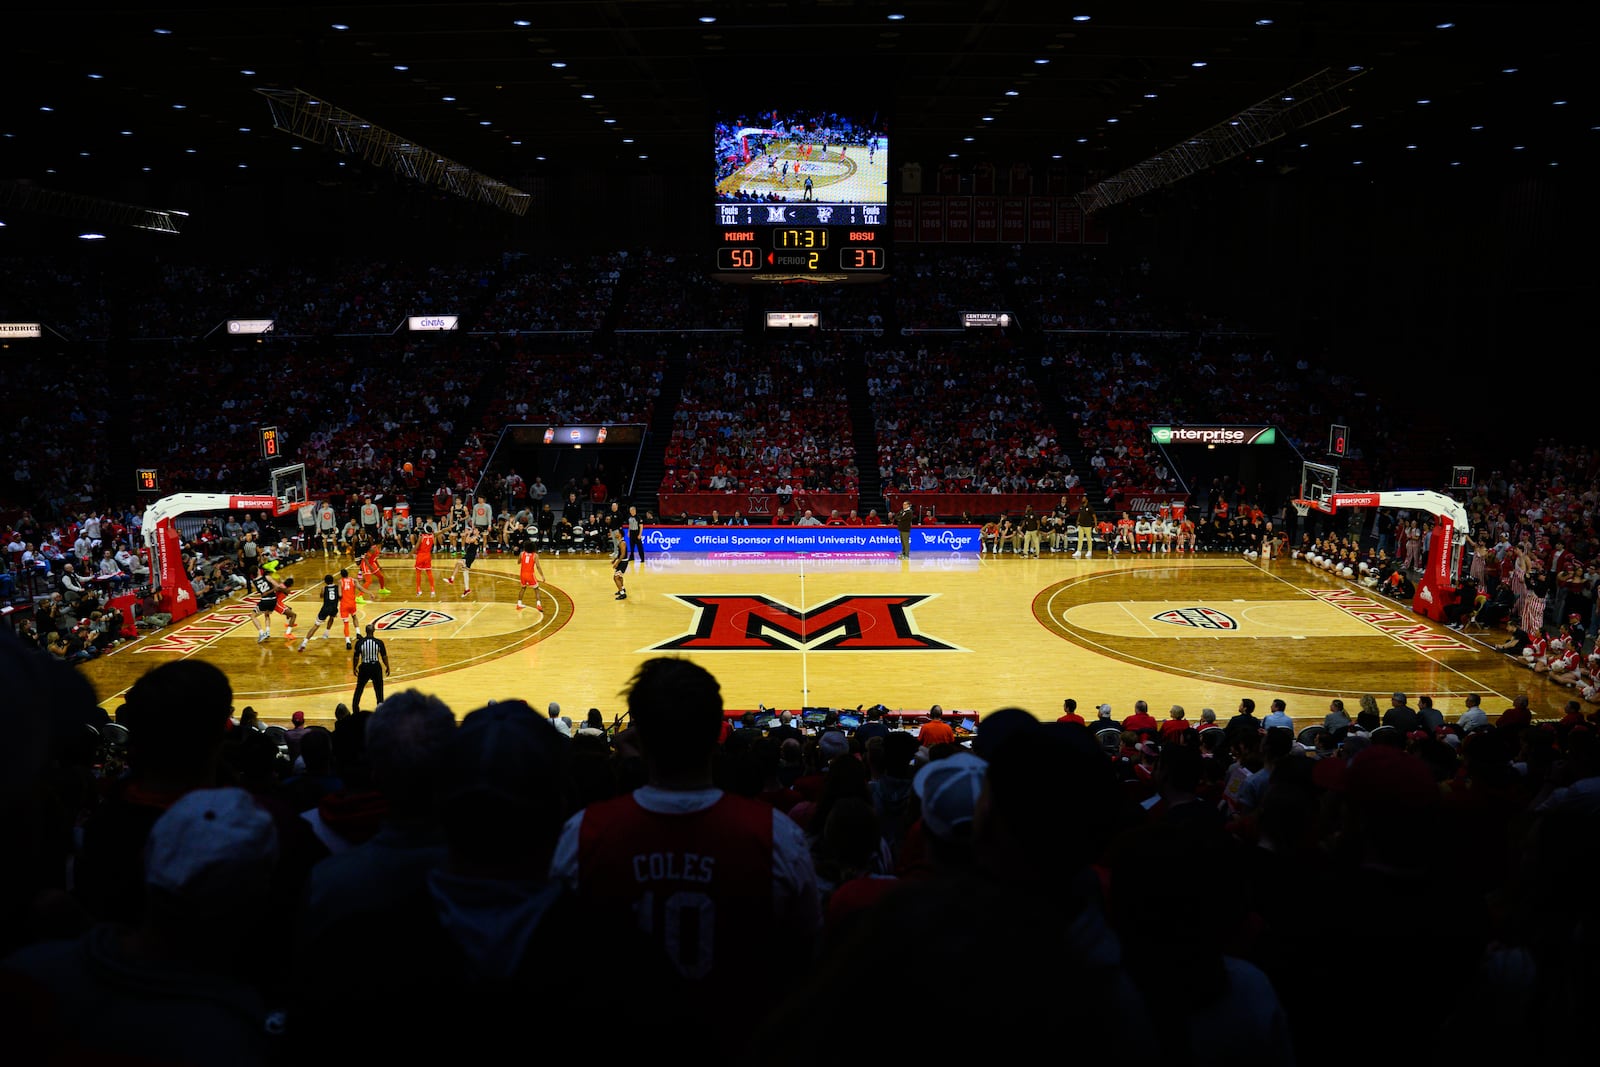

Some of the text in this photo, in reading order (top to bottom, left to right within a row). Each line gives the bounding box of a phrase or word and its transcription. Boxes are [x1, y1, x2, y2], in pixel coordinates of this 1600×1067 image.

[721, 205, 752, 215] Fouls 2
[862, 205, 880, 215] Fouls
[721, 215, 738, 225] T.O.L.
[864, 215, 880, 225] T.O.L.
[725, 232, 754, 241] MIAMI
[783, 230, 826, 248] 17:31
[849, 232, 875, 241] BGSU
[731, 250, 753, 267] 50
[777, 256, 806, 265] PERIOD
[808, 252, 819, 269] 2
[855, 250, 876, 267] 37
[1156, 428, 1245, 442] enterprise
[267, 439, 275, 454] 8
[145, 479, 154, 488] 13
[646, 530, 681, 550] Kroger
[693, 535, 912, 546] Official Sponsor of Miami University Athletis
[937, 530, 972, 550] Kroger
[328, 590, 336, 600] 6
[634, 592, 973, 651] M
[1303, 587, 1480, 653] MIAMI
[632, 852, 716, 883] COLES
[631, 889, 716, 980] 10
